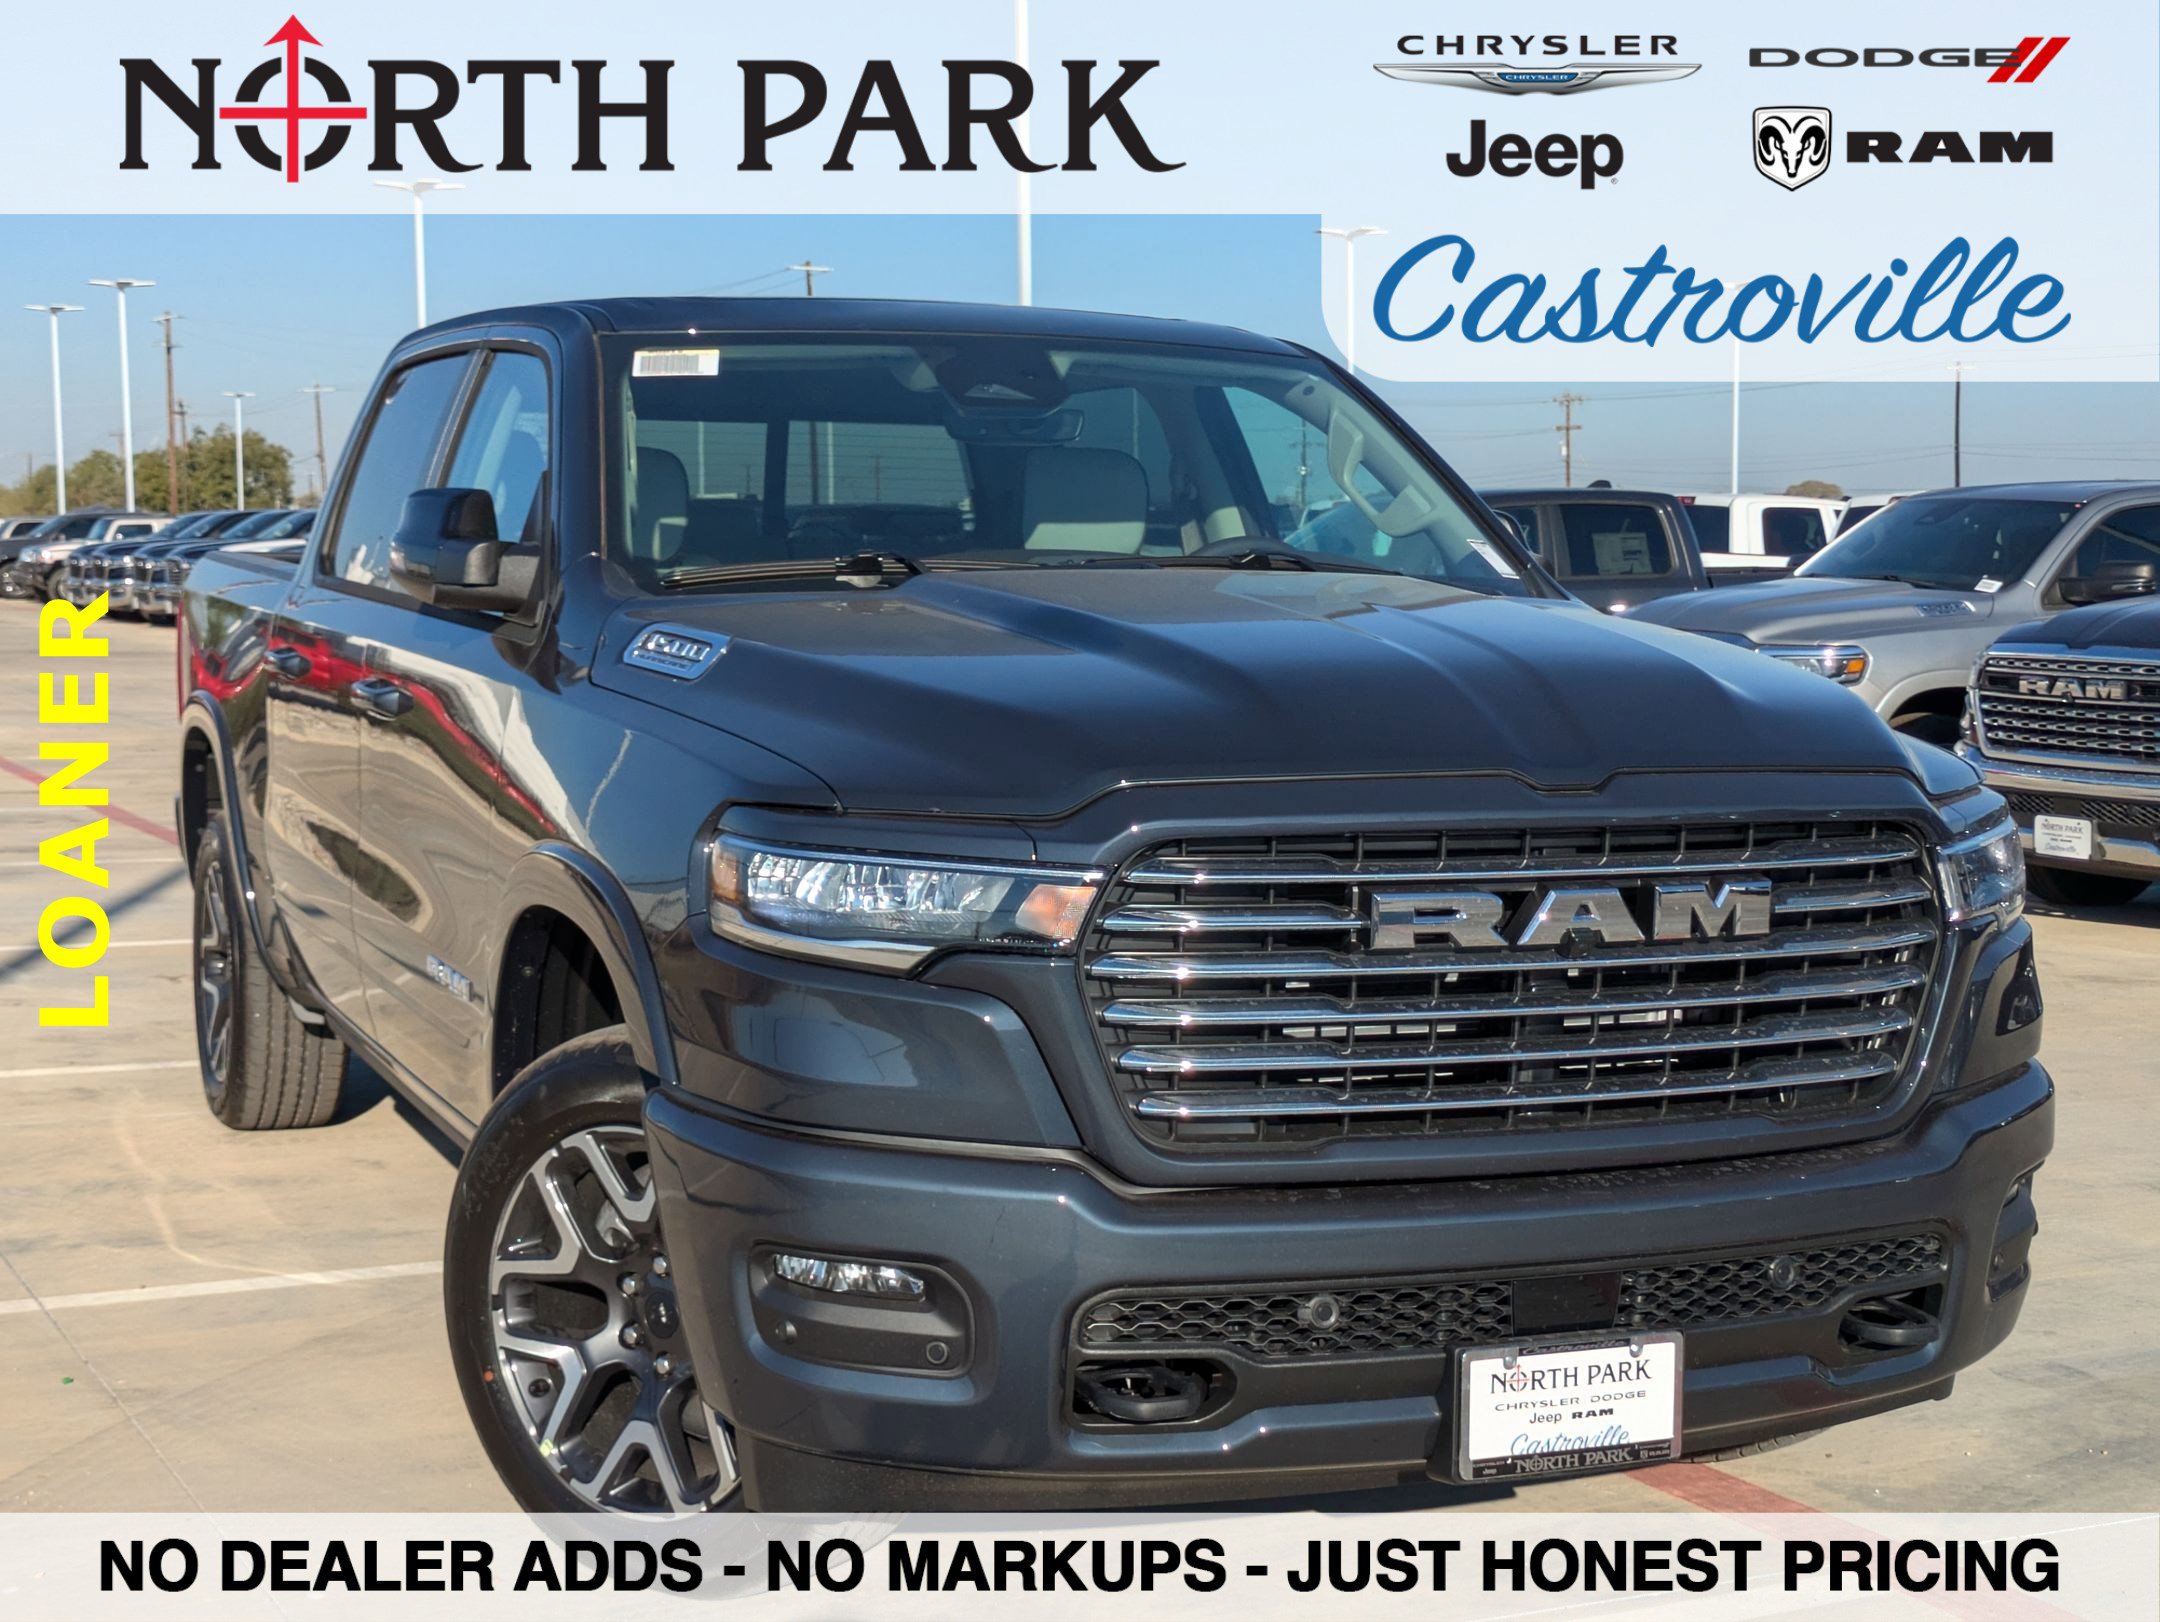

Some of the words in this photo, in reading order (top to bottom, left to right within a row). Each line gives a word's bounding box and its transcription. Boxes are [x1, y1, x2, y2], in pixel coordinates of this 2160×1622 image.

[2019, 675, 2127, 700] RAM
[1371, 876, 1772, 949] RAM
[1490, 1366, 1579, 1394] NORTH
[1587, 1359, 1653, 1385] PARK
[1495, 1397, 1580, 1412] CHRYSLER
[1590, 1390, 1647, 1403] DODGE
[1529, 1412, 1562, 1424] Jeep
[1571, 1408, 1614, 1420] RAM
[1511, 1424, 1630, 1455] Castroville
[1514, 1453, 1580, 1473] NORTH
[1583, 1447, 1632, 1466] PARK
